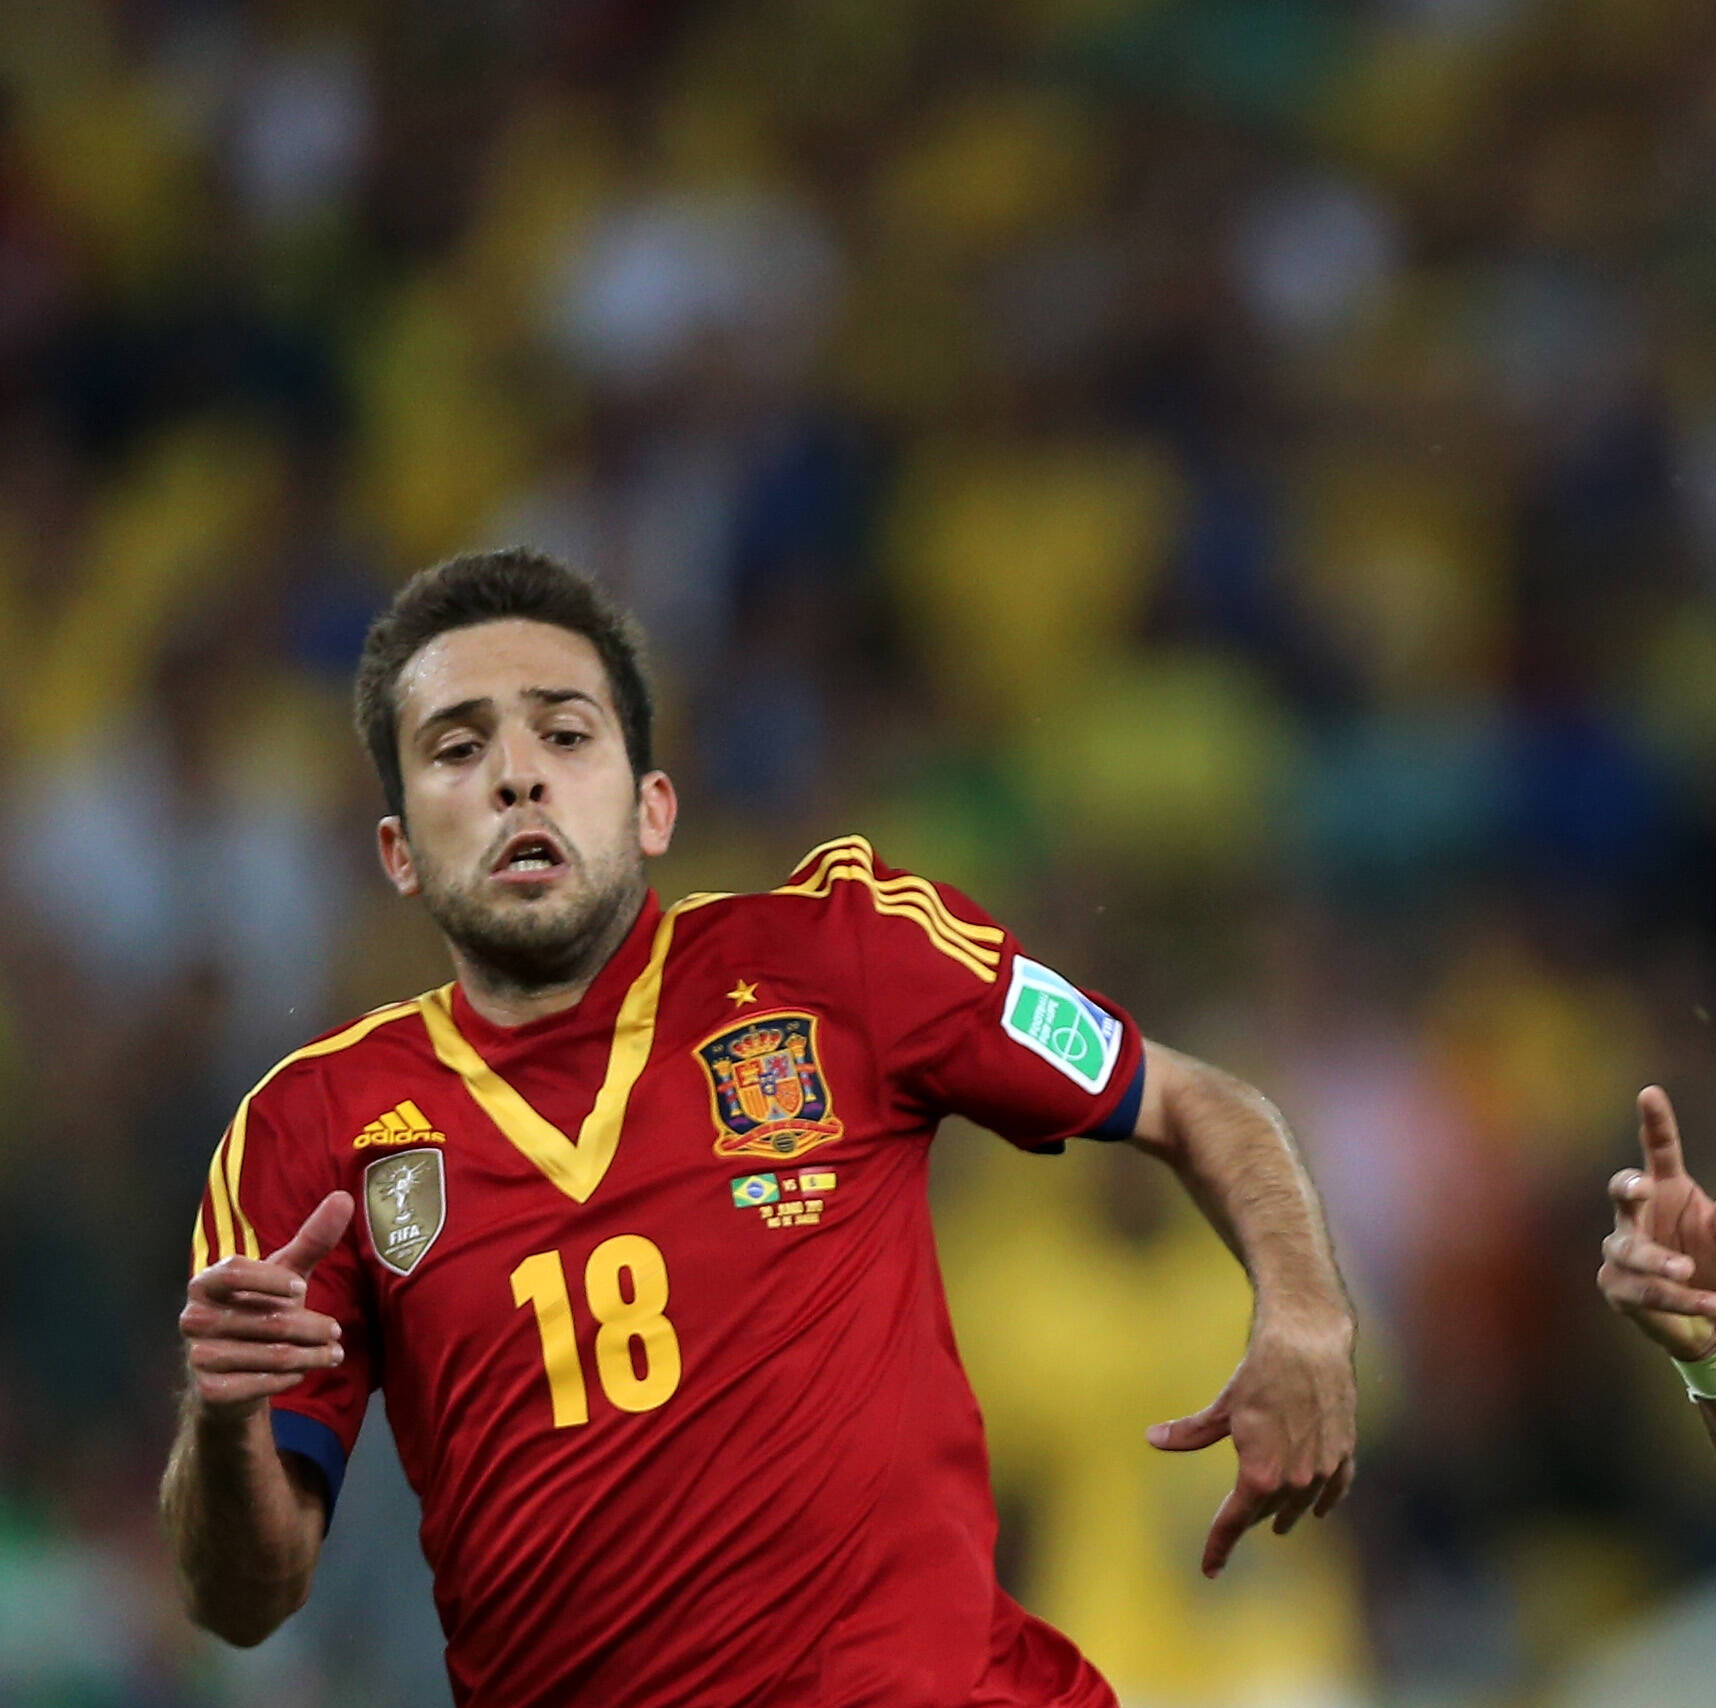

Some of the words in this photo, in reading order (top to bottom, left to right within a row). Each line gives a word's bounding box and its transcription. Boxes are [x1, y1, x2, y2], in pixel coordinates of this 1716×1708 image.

[353, 1129, 447, 1149] adidas
[389, 1224, 421, 1246] FIFA
[510, 1234, 682, 1428] 18
